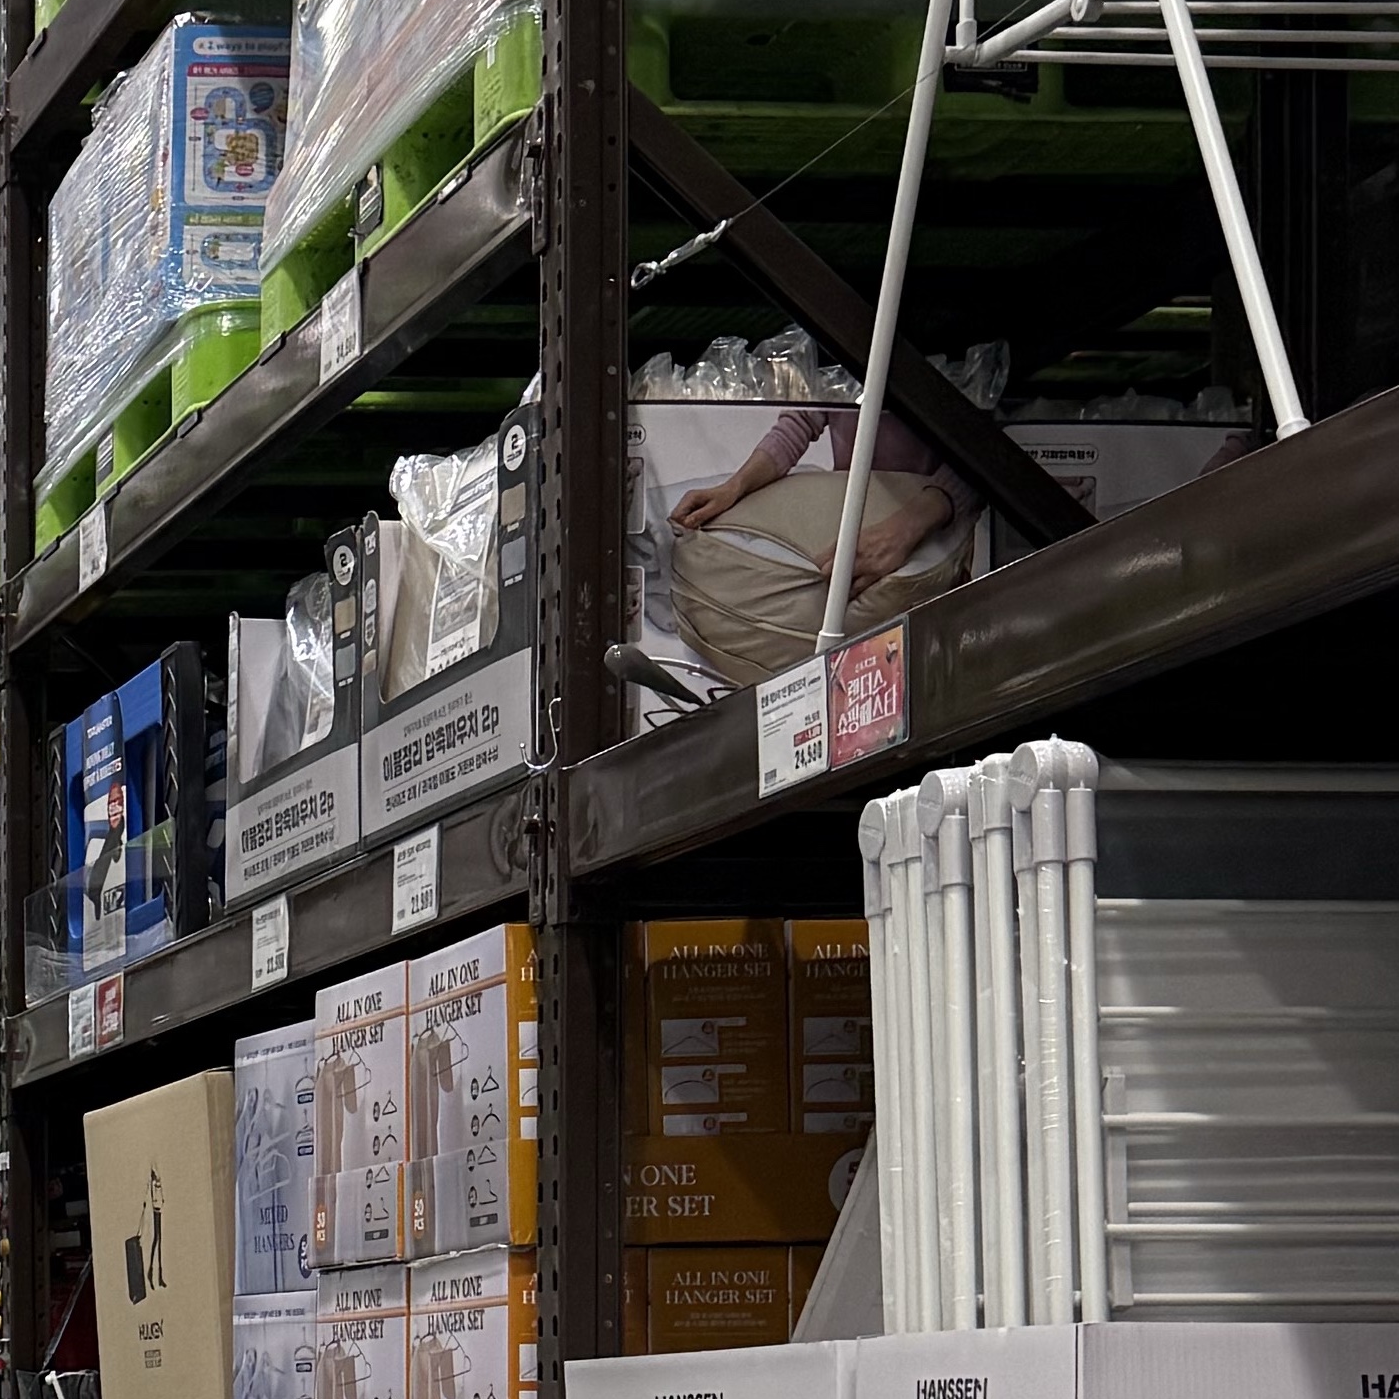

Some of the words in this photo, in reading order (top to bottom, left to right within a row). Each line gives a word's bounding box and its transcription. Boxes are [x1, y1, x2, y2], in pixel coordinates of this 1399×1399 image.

[429, 970, 446, 997] ALL
[448, 965, 458, 991] IN
[460, 958, 480, 985] ONE
[364, 991, 382, 1014] ONE
[465, 992, 482, 1017] SET
[368, 1023, 384, 1043] SET
[640, 1164, 696, 1186] ONE
[667, 1194, 715, 1217] SET
[364, 1288, 382, 1308] ONE
[431, 1280, 448, 1303] ALL
[450, 1278, 460, 1299] IN
[462, 1275, 482, 1297] ONE
[368, 1320, 384, 1340] SET
[467, 1309, 485, 1331] SET
